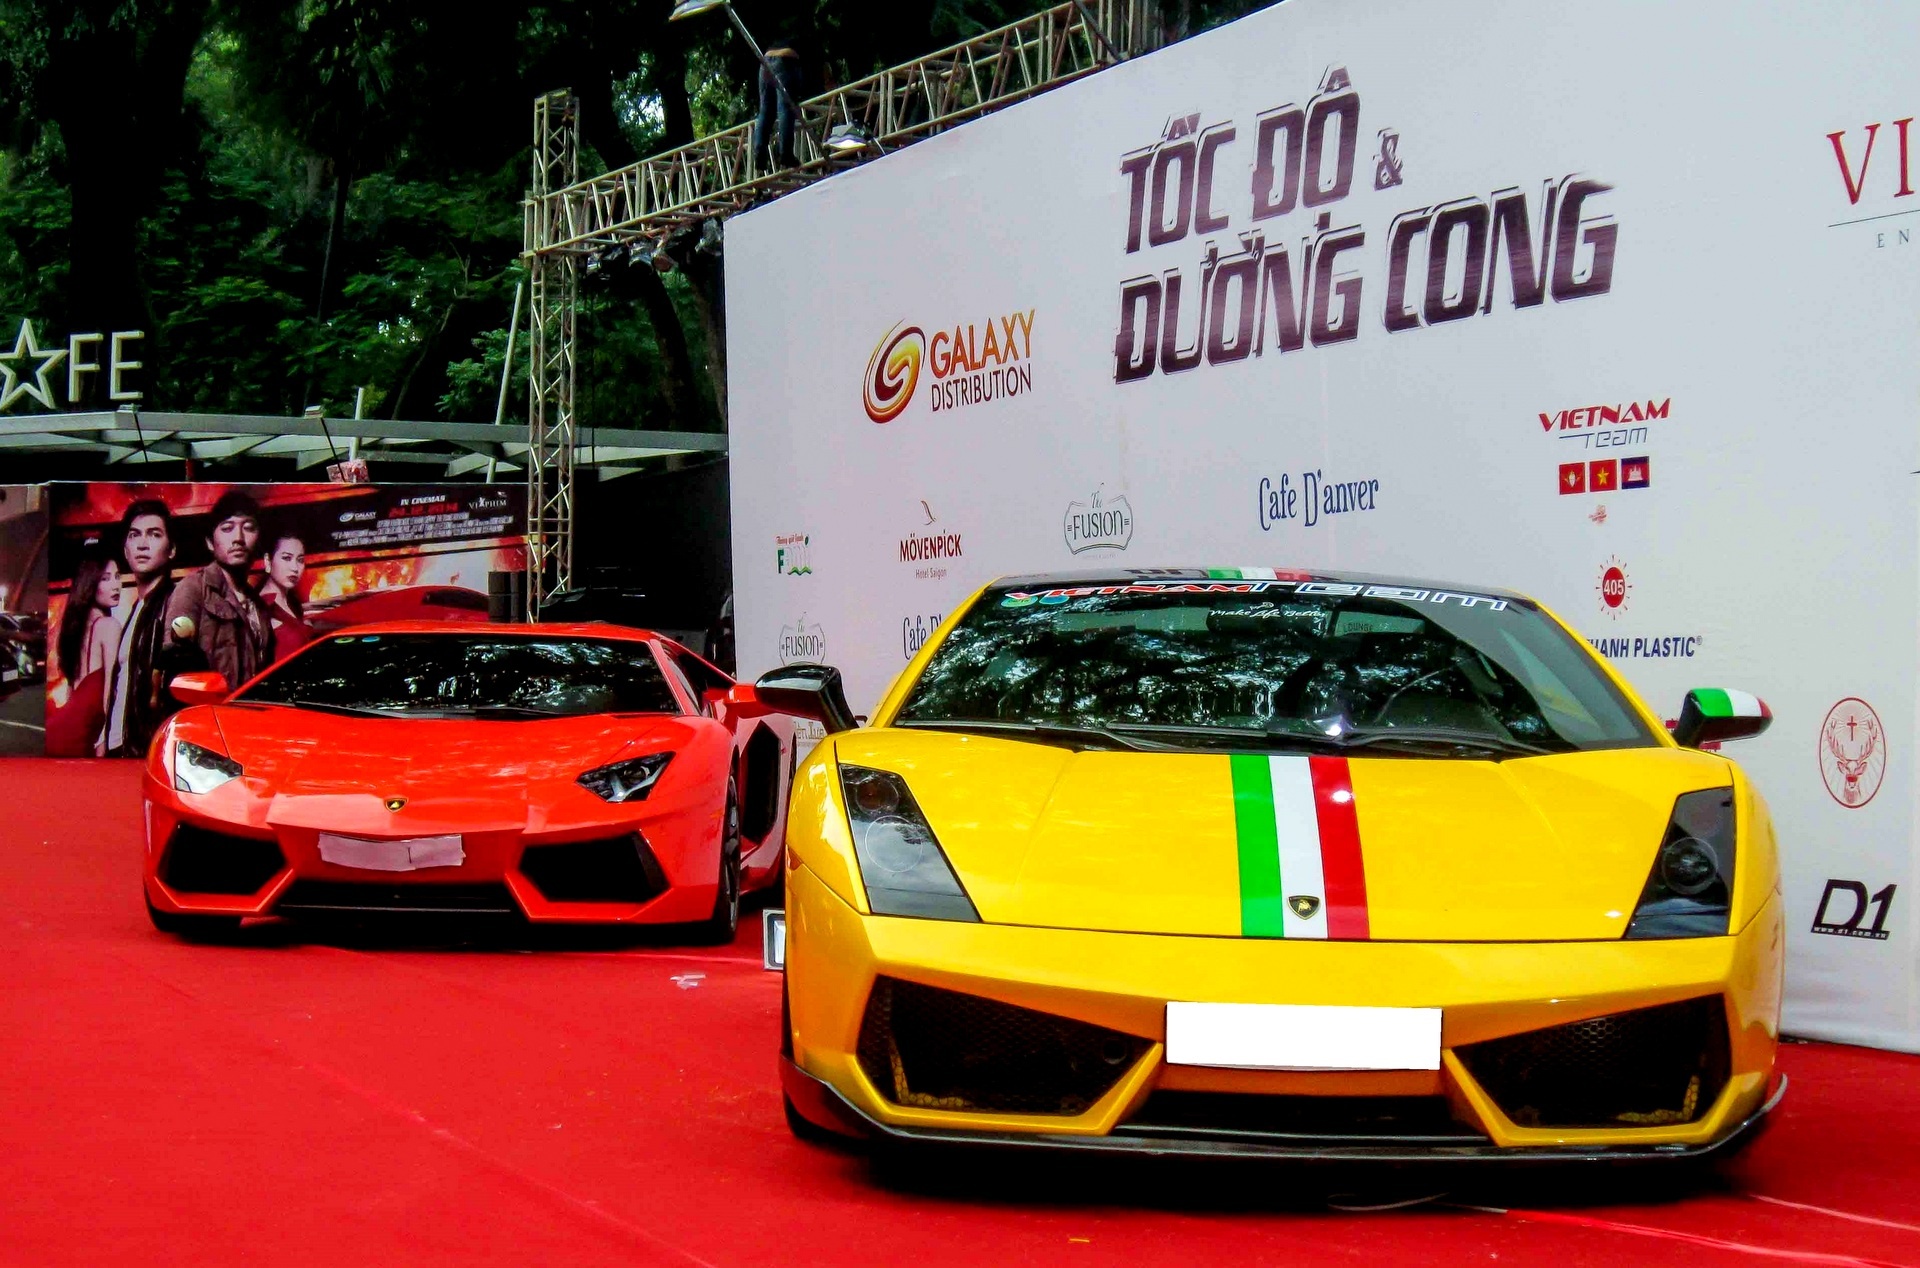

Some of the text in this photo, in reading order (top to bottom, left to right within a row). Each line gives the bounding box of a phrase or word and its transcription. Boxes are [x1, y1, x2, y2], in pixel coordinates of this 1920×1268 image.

[1373, 127, 1404, 191] &
[1382, 171, 1619, 334] CONG
[930, 308, 1035, 379] GALAXY
[931, 363, 1032, 412] DISTRIBUTION
[1538, 397, 1671, 432] VIETNAM
[1259, 469, 1380, 531] Cafe D'anver
[900, 529, 963, 563] MÖVENPICK
[1005, 584, 1252, 598] VIETNAM
[1603, 578, 1625, 596] 405
[1811, 878, 1898, 932] D1
